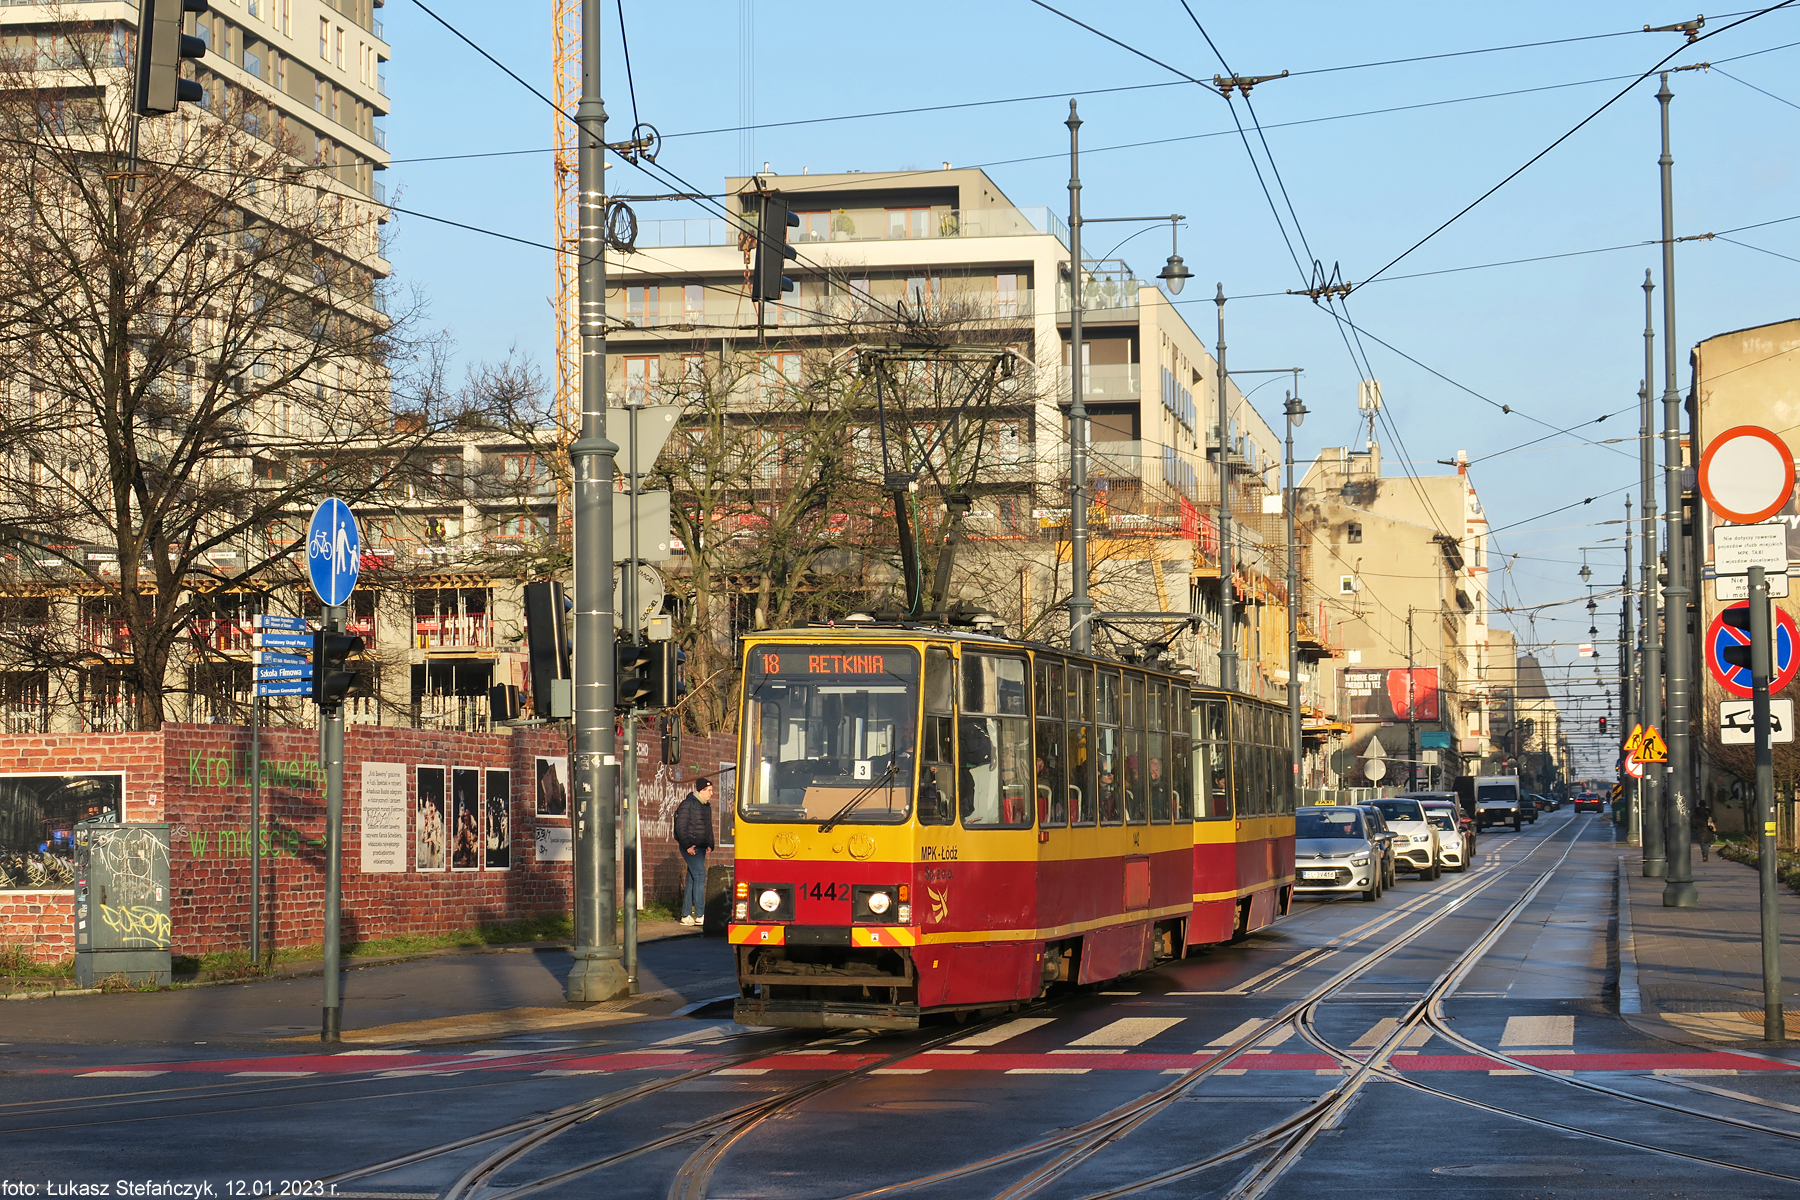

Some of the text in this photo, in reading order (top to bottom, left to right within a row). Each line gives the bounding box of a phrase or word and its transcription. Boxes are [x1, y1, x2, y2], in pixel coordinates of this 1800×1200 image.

[762, 654, 884, 674] 18 RETKINIA
[279, 668, 302, 677] Filmowa
[1368, 673, 1381, 681] CENY
[189, 746, 235, 787] Król
[860, 765, 866, 776] 3
[189, 817, 299, 858] w mieście
[937, 869, 941, 879] z
[799, 882, 850, 900] 1442
